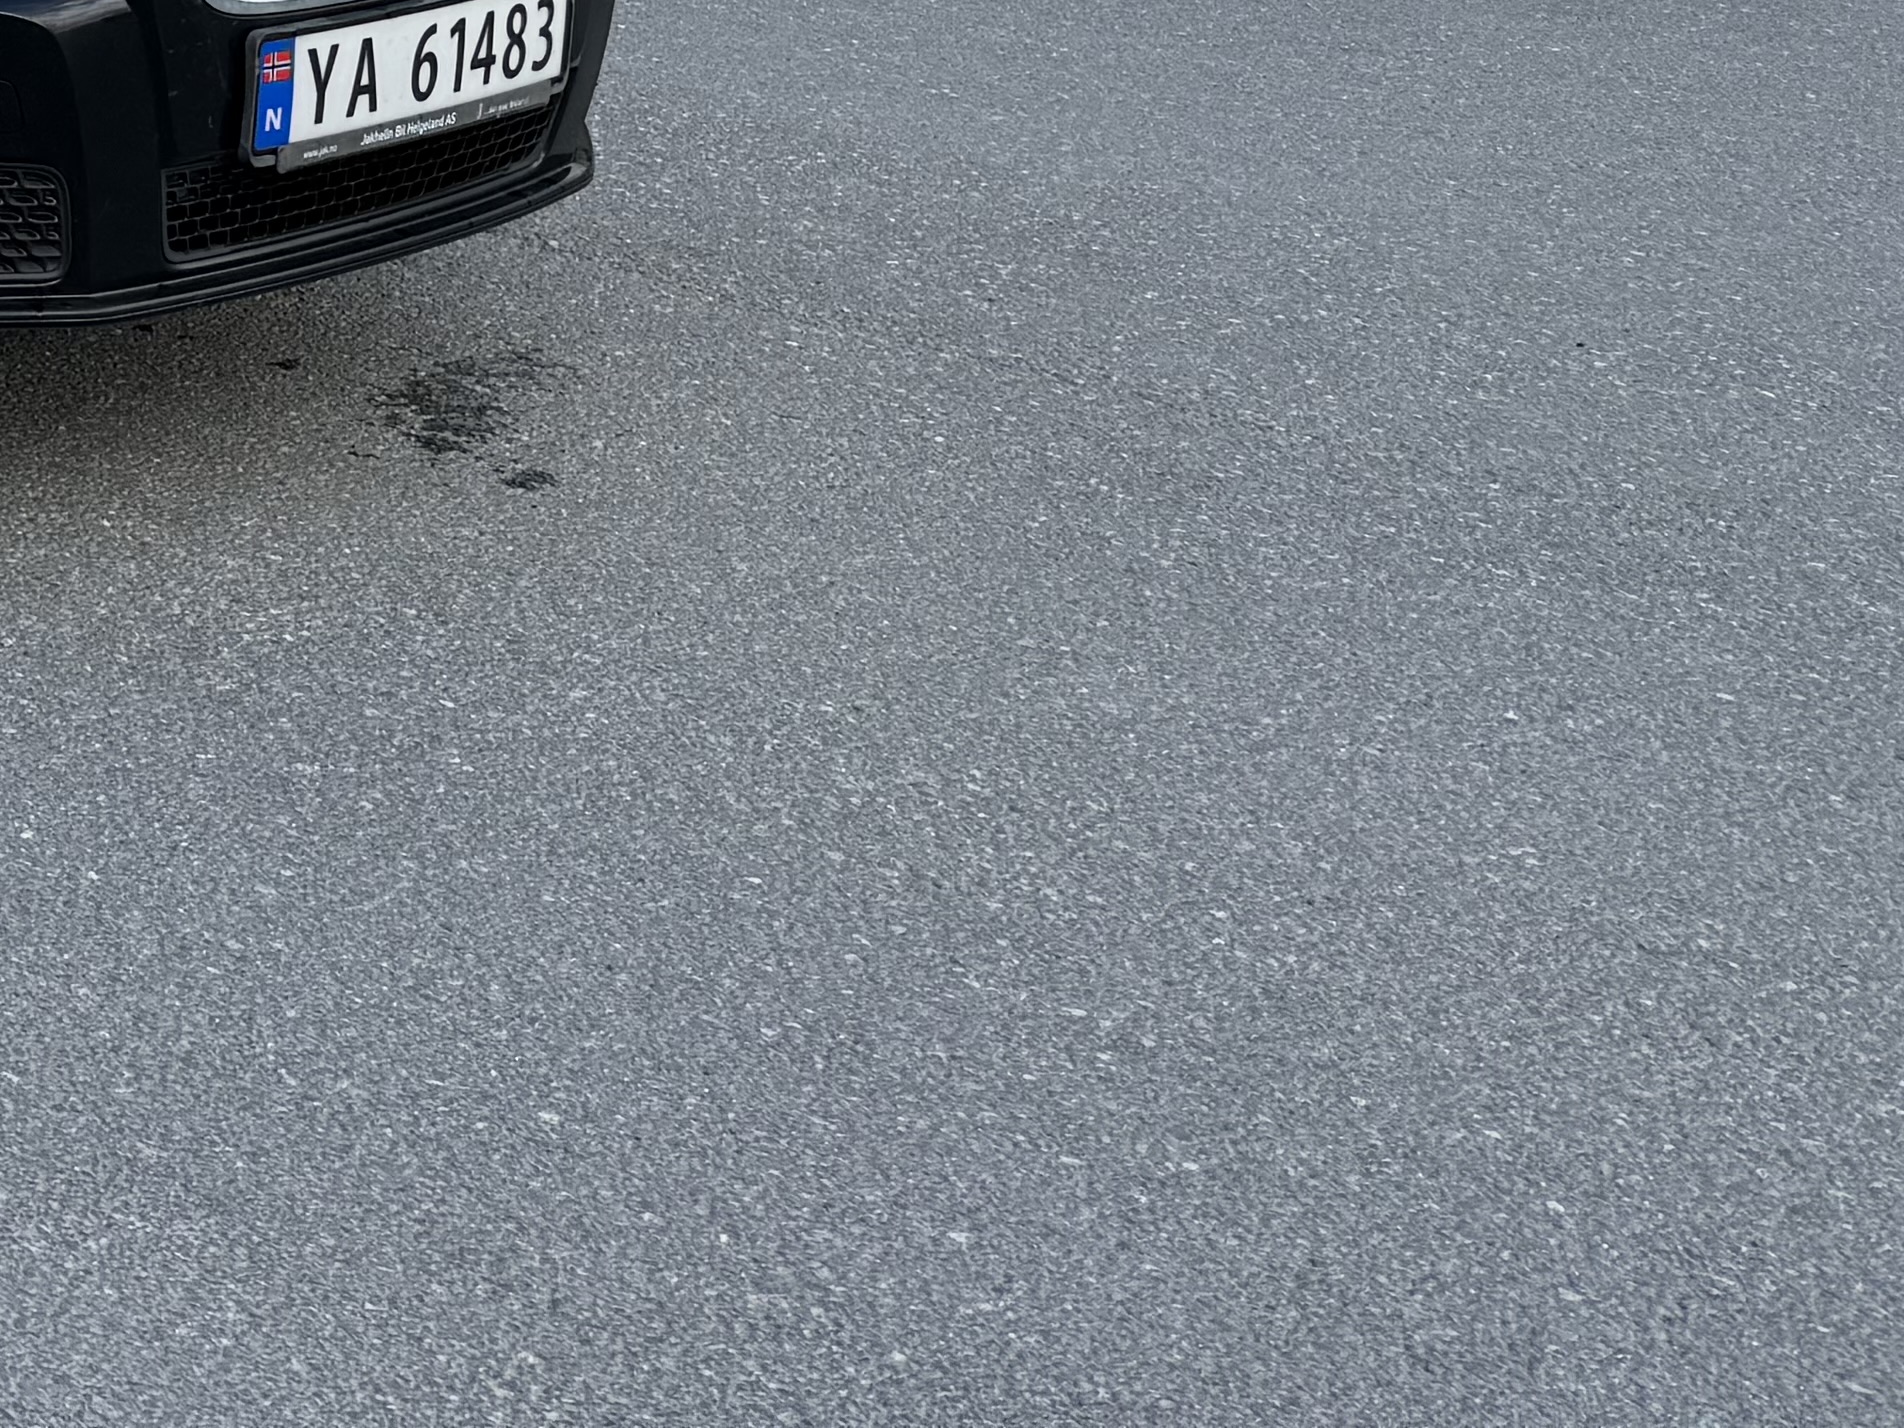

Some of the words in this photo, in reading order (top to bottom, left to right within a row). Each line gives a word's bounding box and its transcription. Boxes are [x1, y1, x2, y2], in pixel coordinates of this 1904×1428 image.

[307, 37, 378, 124] YA
[265, 107, 283, 132] N
[445, 111, 457, 126] AS
